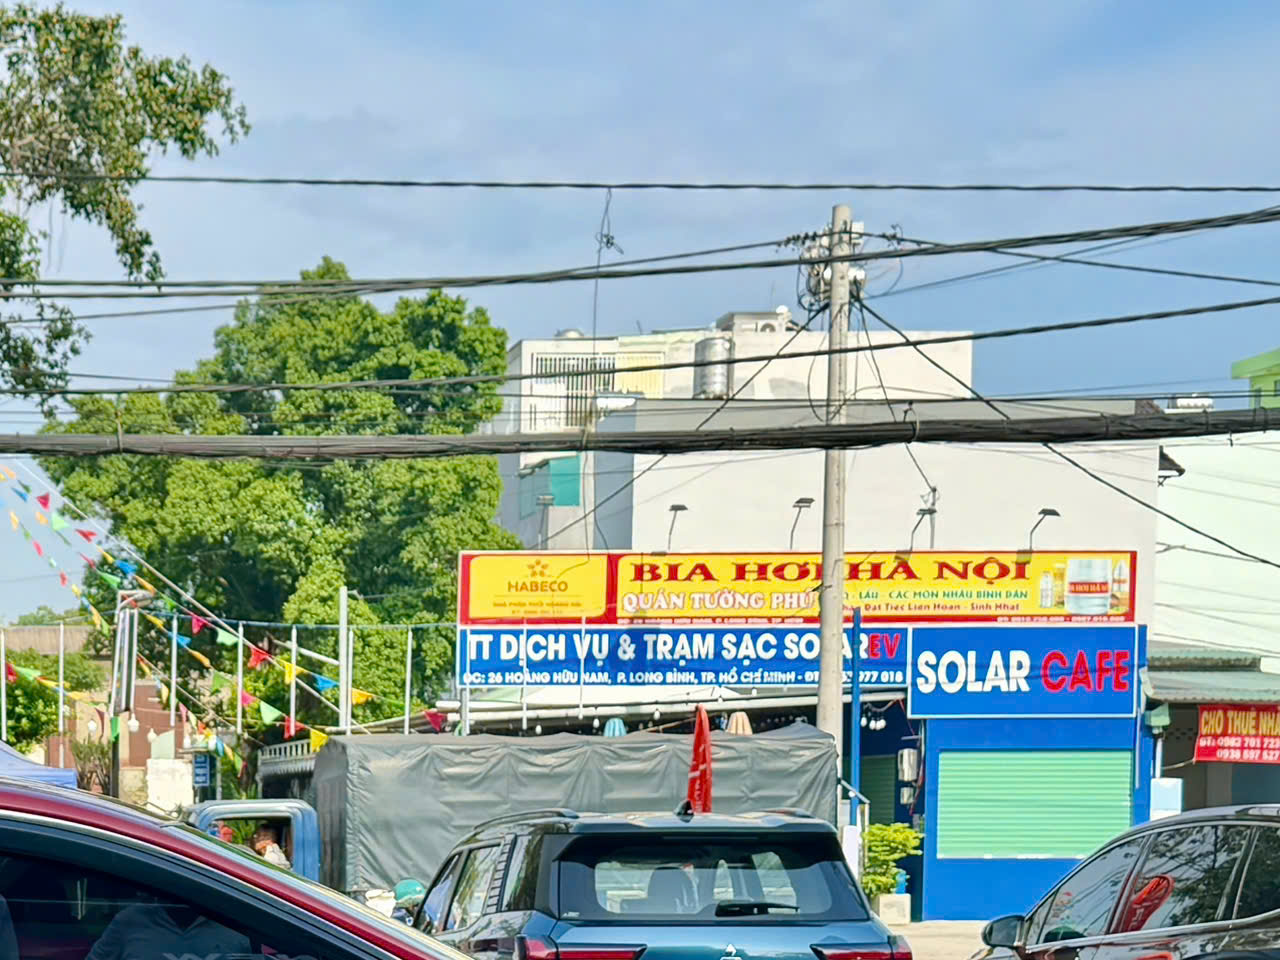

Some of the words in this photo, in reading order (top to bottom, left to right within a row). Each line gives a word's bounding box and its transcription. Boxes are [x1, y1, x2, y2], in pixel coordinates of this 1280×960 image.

[630, 562, 720, 582] BIA
[731, 561, 822, 582] HƠI
[844, 555, 921, 581] HÀ
[933, 556, 1030, 585] NỘI
[507, 580, 568, 593] HABECO
[623, 588, 685, 612] QUÁN
[500, 633, 566, 667] DỊCH
[573, 633, 609, 666] VỤ
[618, 633, 636, 661] &
[643, 633, 715, 667] TRẠM
[721, 632, 778, 666] SẠC
[629, 671, 663, 683] LONG
[916, 650, 1032, 694] SOLAR
[1041, 649, 1130, 693] CAFE
[1201, 710, 1225, 735] CHO
[1227, 707, 1257, 735] THUÊ
